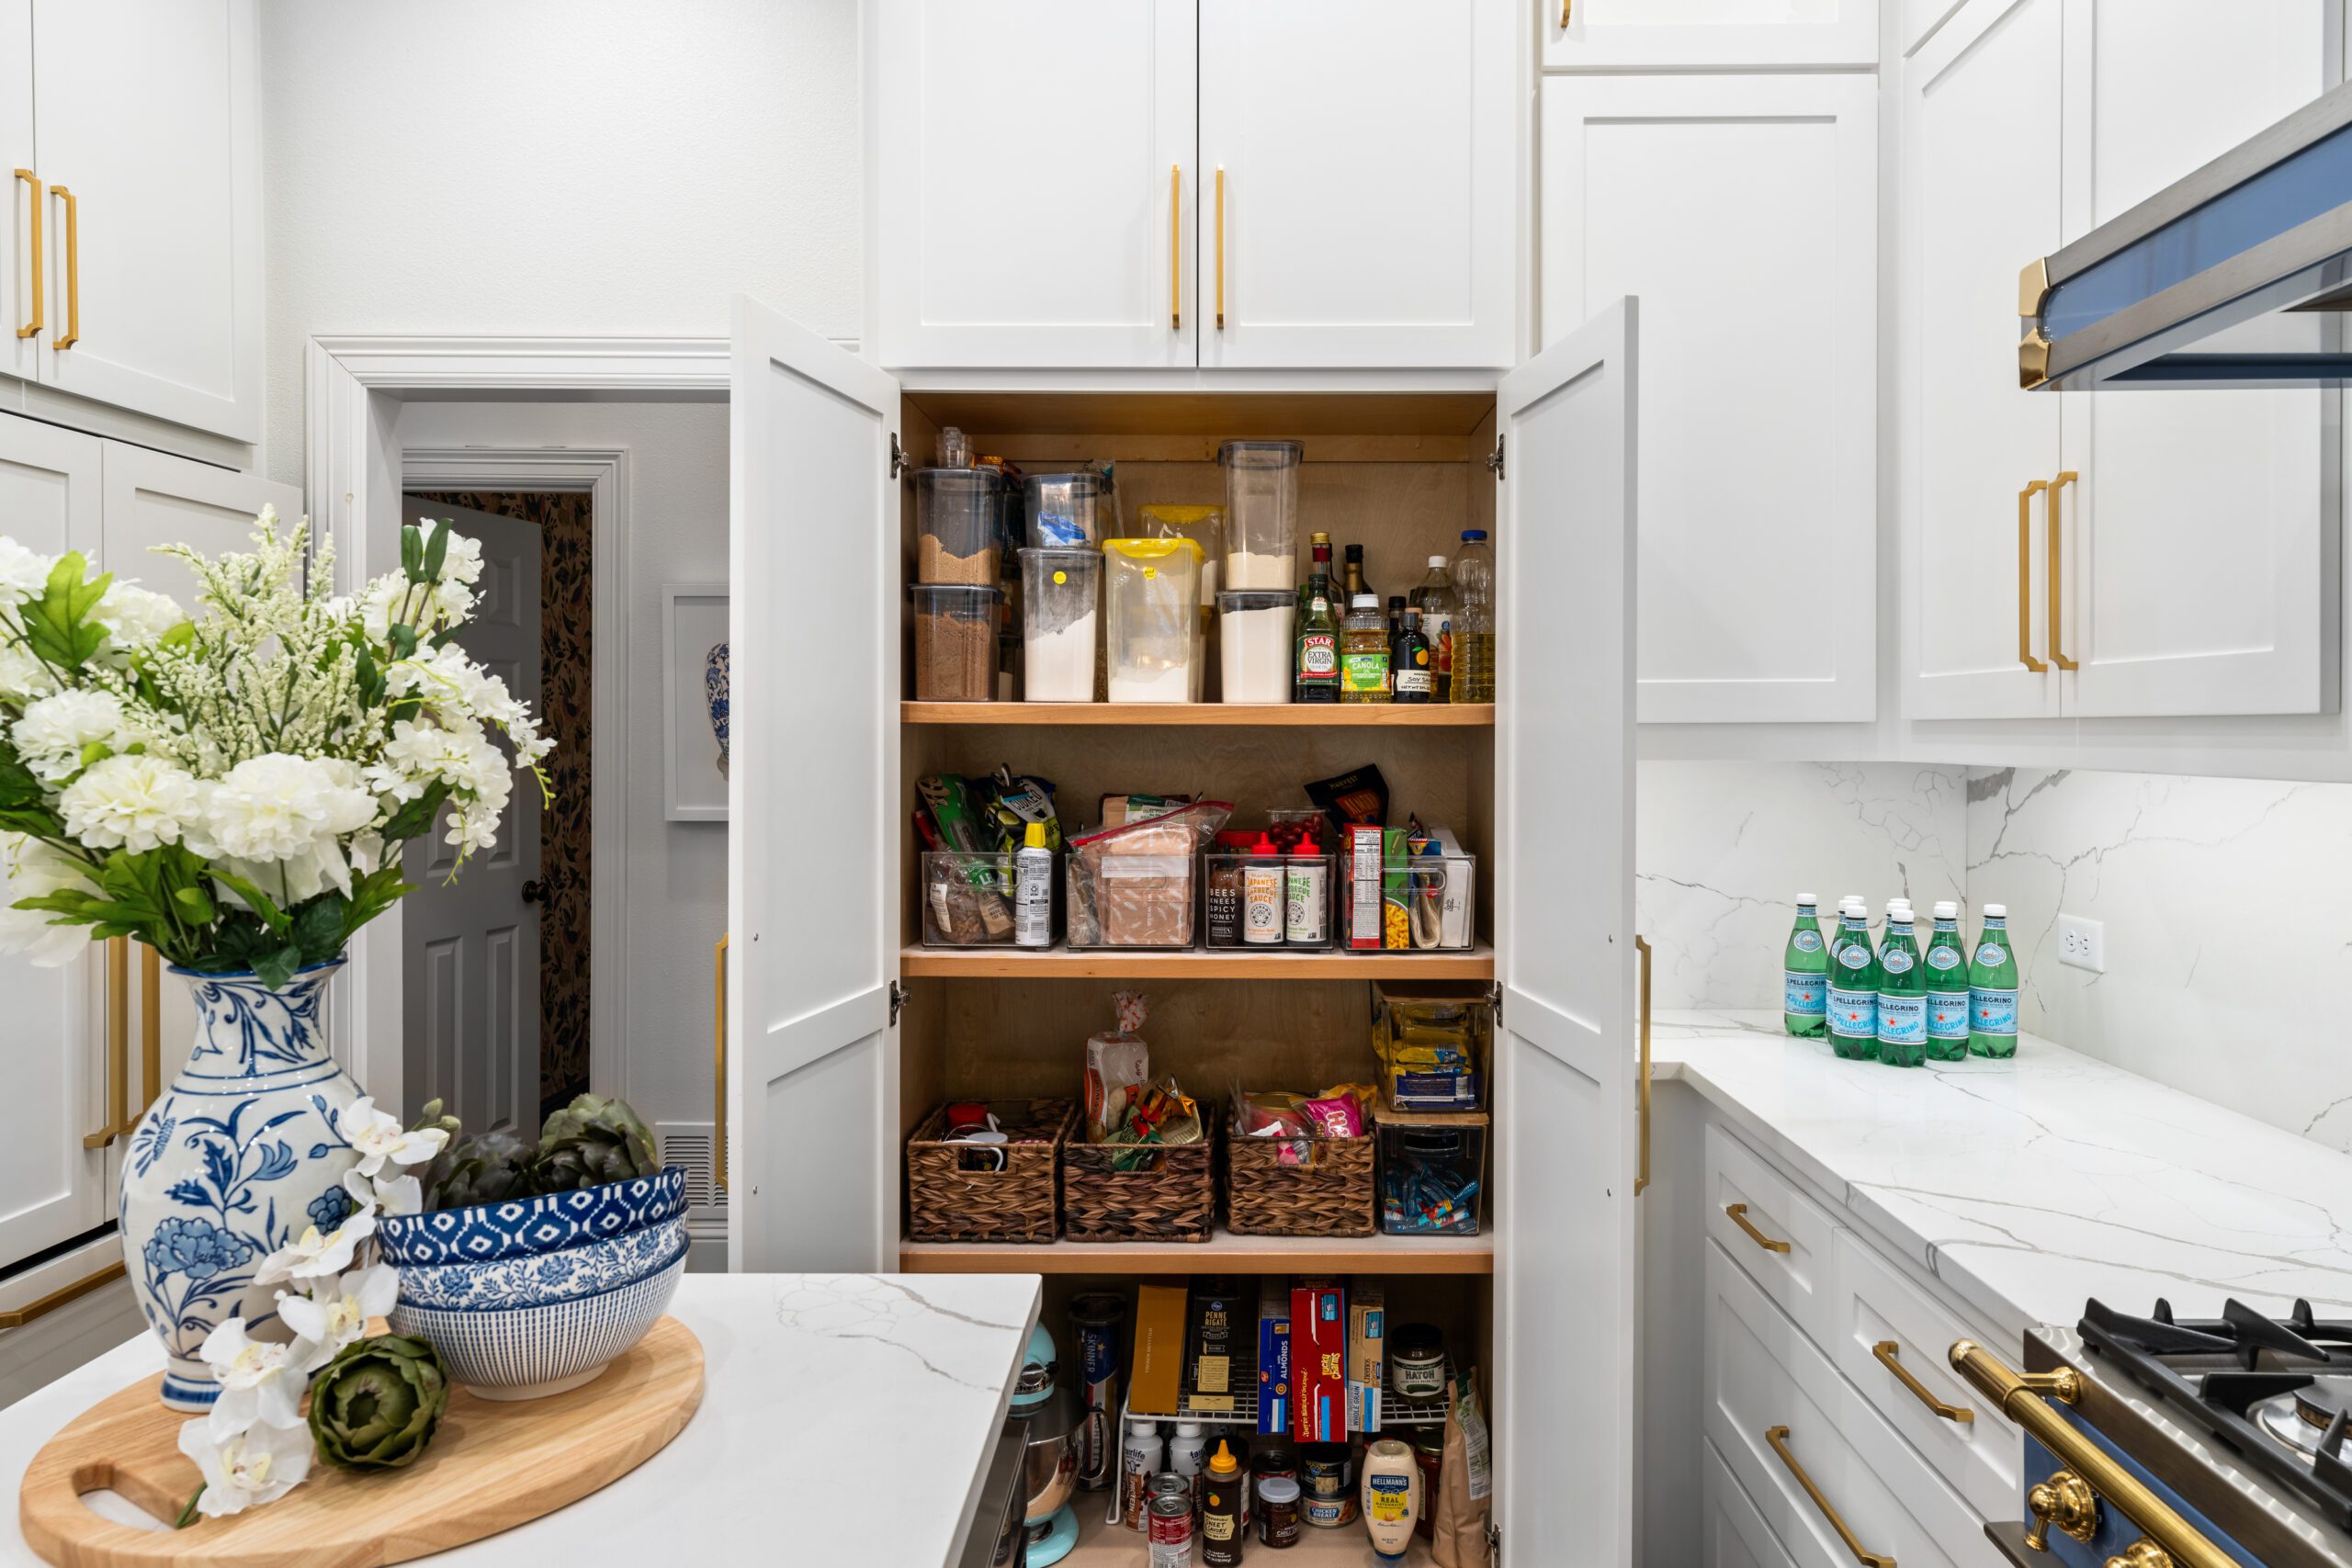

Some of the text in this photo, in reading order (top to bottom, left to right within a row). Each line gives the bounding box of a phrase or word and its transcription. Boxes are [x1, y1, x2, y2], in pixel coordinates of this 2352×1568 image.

[1307, 637, 1331, 647] STAR
[1352, 661, 1379, 670] CANOLA
[1247, 875, 1278, 888] JAPANESE
[1209, 888, 1236, 897] BEES
[1247, 886, 1278, 898] BARBECUE
[1250, 895, 1272, 904] SAUCE
[1288, 893, 1305, 903] AUCE
[1205, 1311, 1227, 1319] PENNE
[1204, 1318, 1227, 1326] RIGATE
[1087, 1333, 1097, 1373] SKINNER
[1281, 1340, 1289, 1380] ALMONDS
[1329, 1352, 1341, 1380] Charms
[1372, 1477, 1408, 1486] HELLMANN'S
